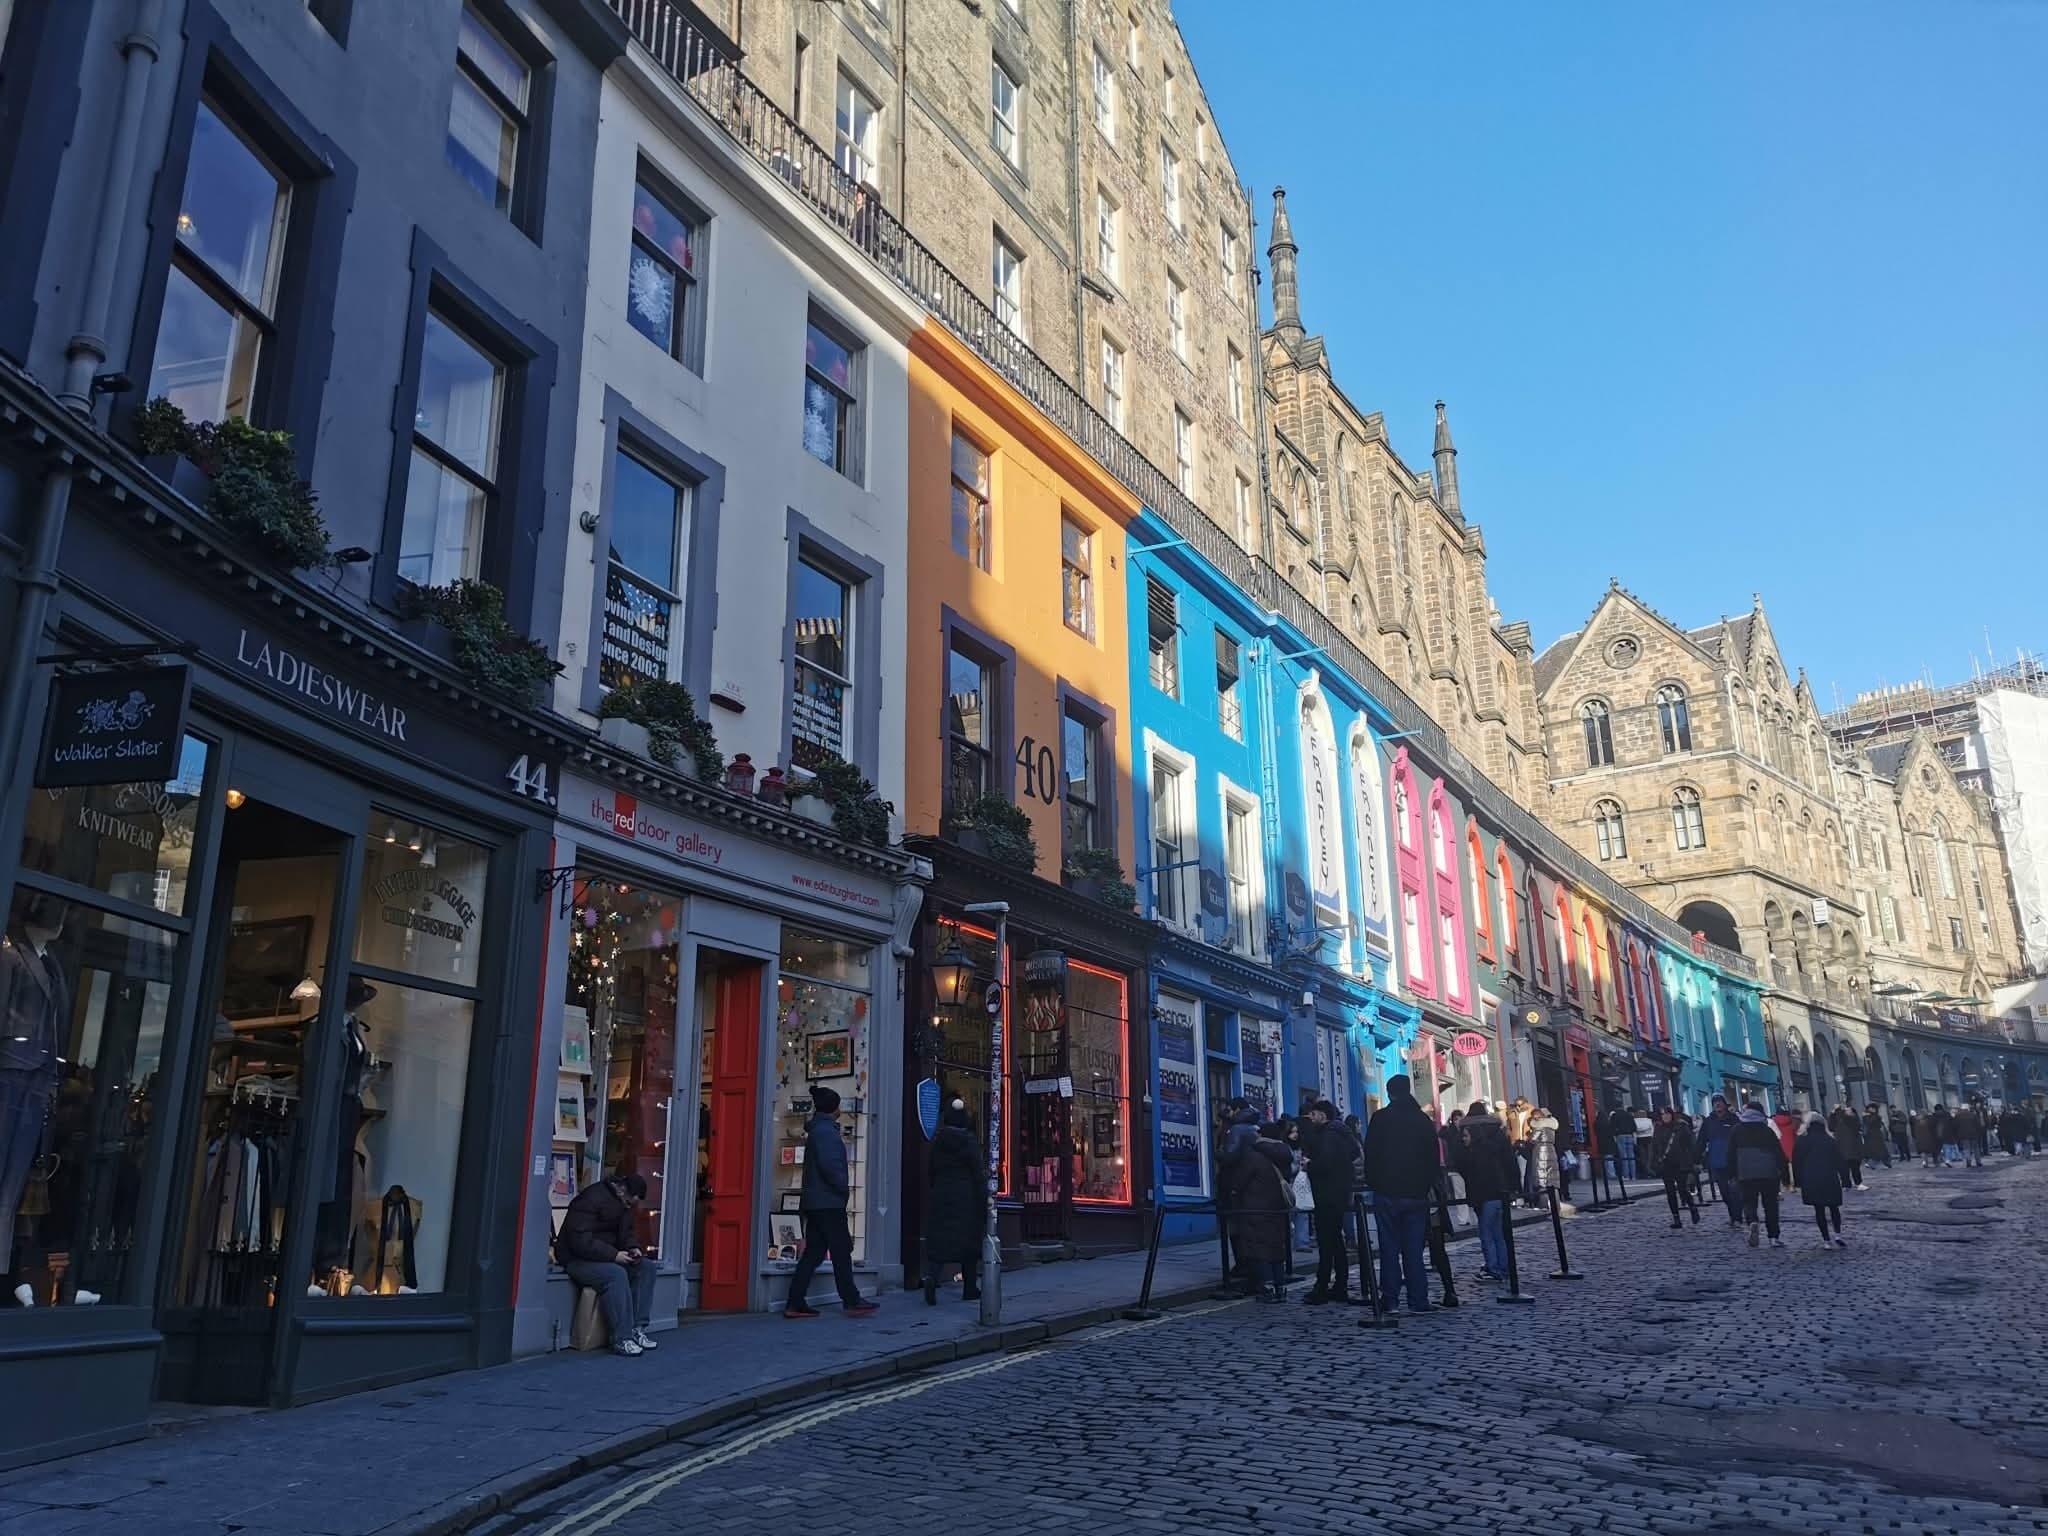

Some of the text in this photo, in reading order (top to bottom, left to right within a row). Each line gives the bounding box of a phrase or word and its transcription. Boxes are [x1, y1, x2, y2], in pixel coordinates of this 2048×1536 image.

[604, 596, 634, 626] oving
[602, 637, 659, 679] ince 2003
[608, 621, 631, 644] and
[631, 629, 669, 662] Design
[237, 629, 407, 741] LADIESWEAR
[55, 739, 163, 762] Walker Slater
[1016, 736, 1055, 805] 40
[79, 807, 154, 850] KNITWEAR
[591, 798, 722, 863] the red door gallery
